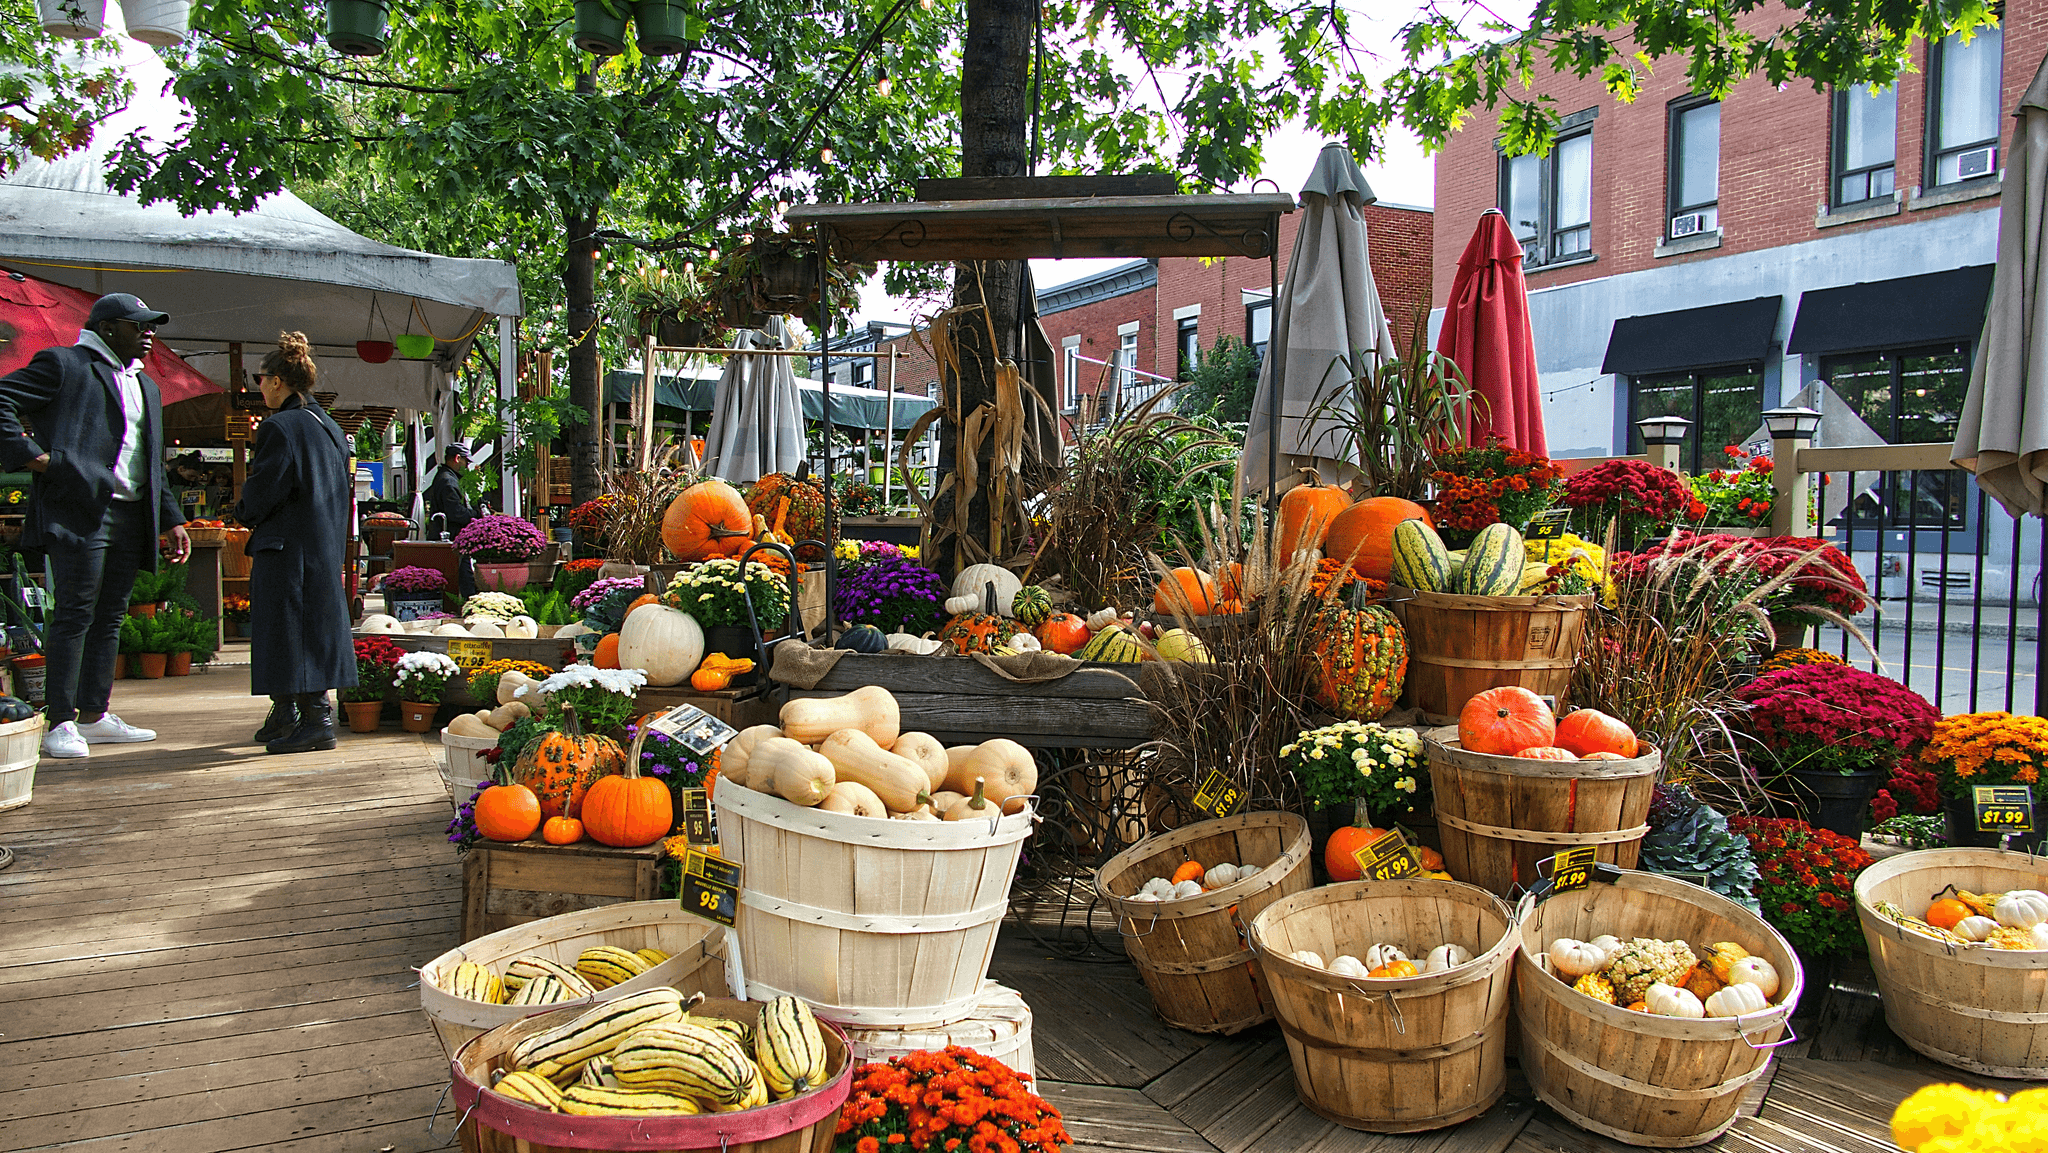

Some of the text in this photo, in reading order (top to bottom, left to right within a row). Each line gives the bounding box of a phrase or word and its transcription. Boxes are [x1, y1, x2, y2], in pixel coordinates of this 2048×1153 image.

[1537, 526, 1554, 535] 95
[694, 725, 714, 740] 95
[1215, 788, 1237, 818] $1.99
[1982, 810, 2024, 824] $1.99
[693, 820, 703, 836] 95
[1375, 857, 1409, 880] $1.99
[1554, 871, 1586, 890] $1.99
[699, 890, 720, 911] 95
